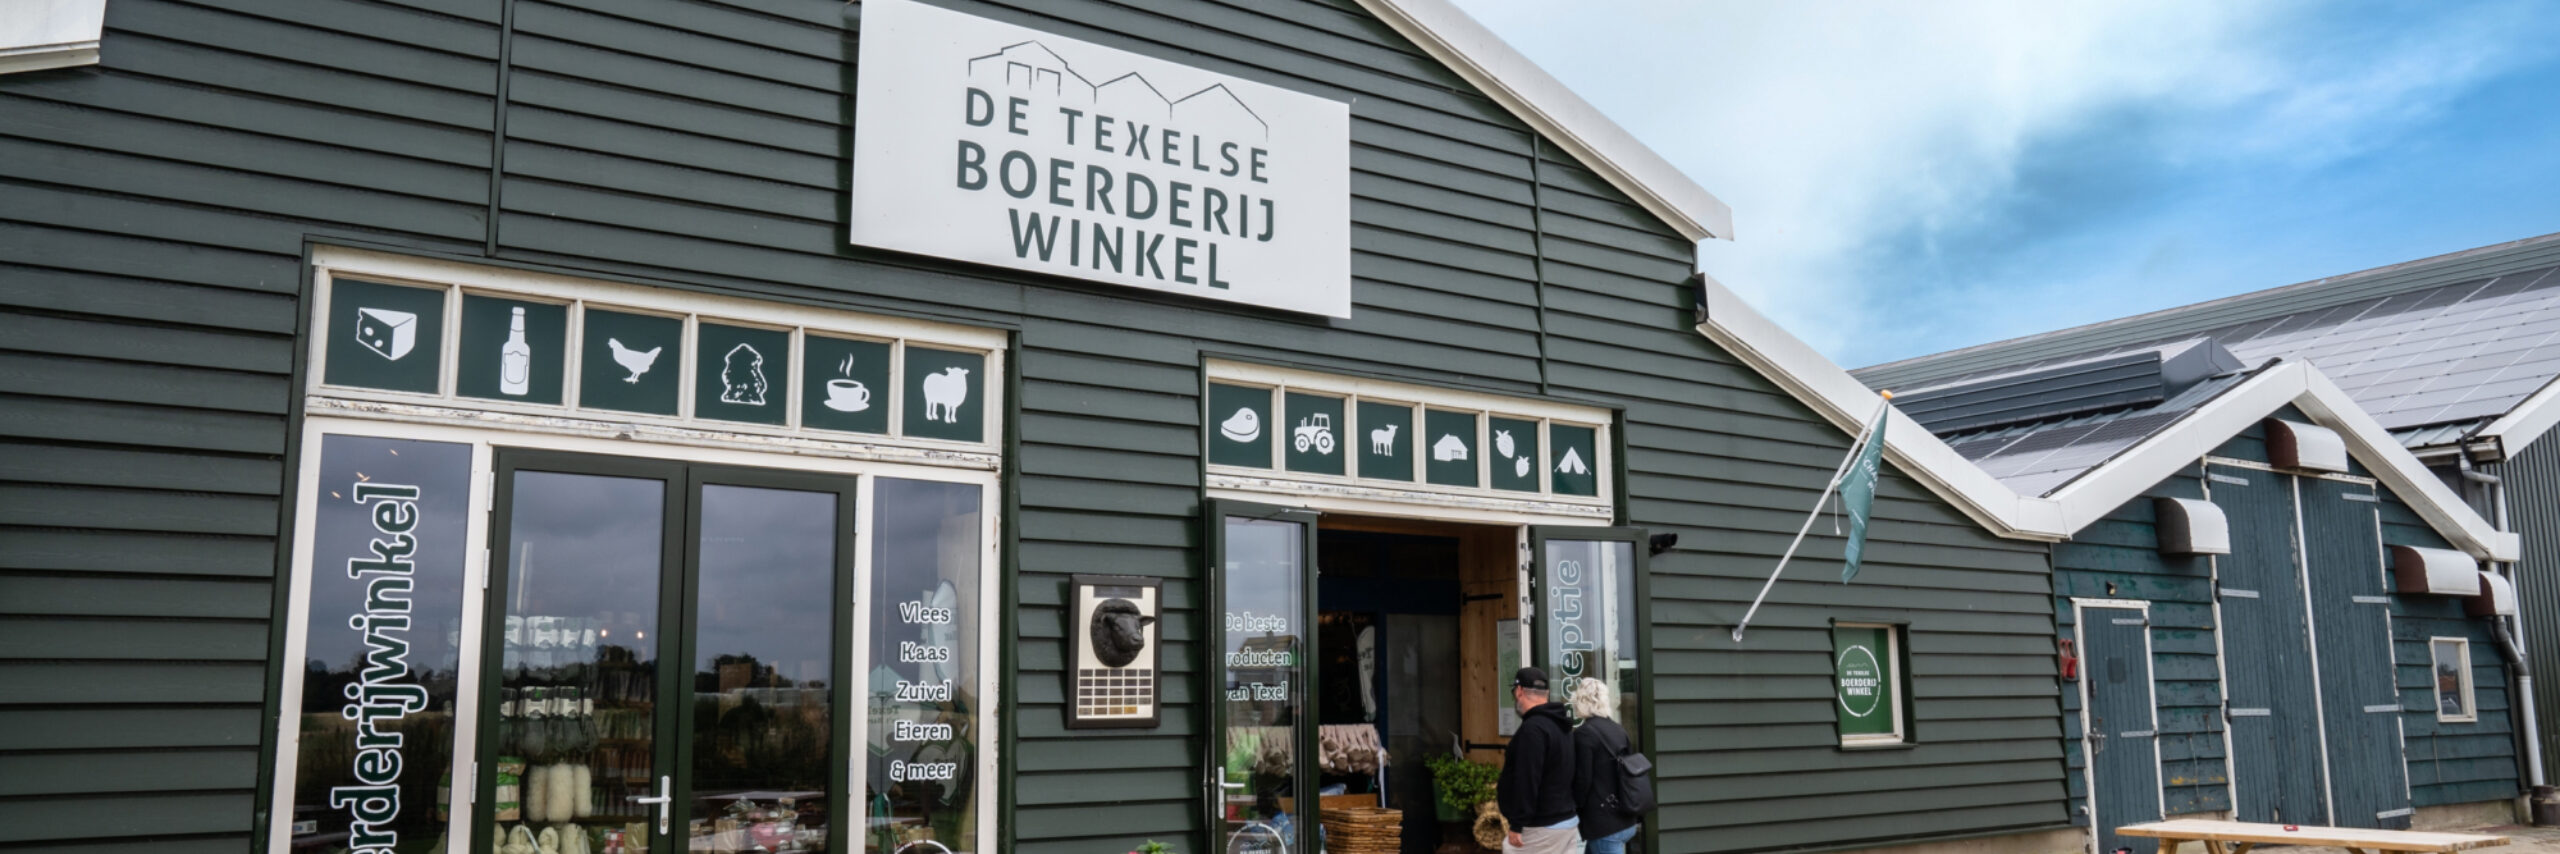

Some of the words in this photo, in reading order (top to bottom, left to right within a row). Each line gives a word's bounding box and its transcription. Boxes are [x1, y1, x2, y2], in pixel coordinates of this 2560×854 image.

[966, 87, 1029, 136] DE
[1059, 106, 1268, 184] TEXELSE
[956, 139, 1275, 242] BOERDERIJ
[1008, 207, 1230, 290] WINKEL
[899, 600, 951, 625] Vlees
[1225, 612, 1243, 632] De
[1243, 611, 1287, 632] beste
[900, 640, 949, 662] Kaas
[1225, 646, 1292, 667] roducten
[330, 482, 429, 854] rderijwinkel
[895, 679, 952, 702] Zuivel
[1250, 680, 1288, 701] Texel
[1841, 678, 1877, 687] BOERDERIJ
[1847, 687, 1872, 696] WINKEL
[894, 720, 952, 741] Eieren
[890, 759, 905, 782] &
[907, 761, 956, 780] meer
